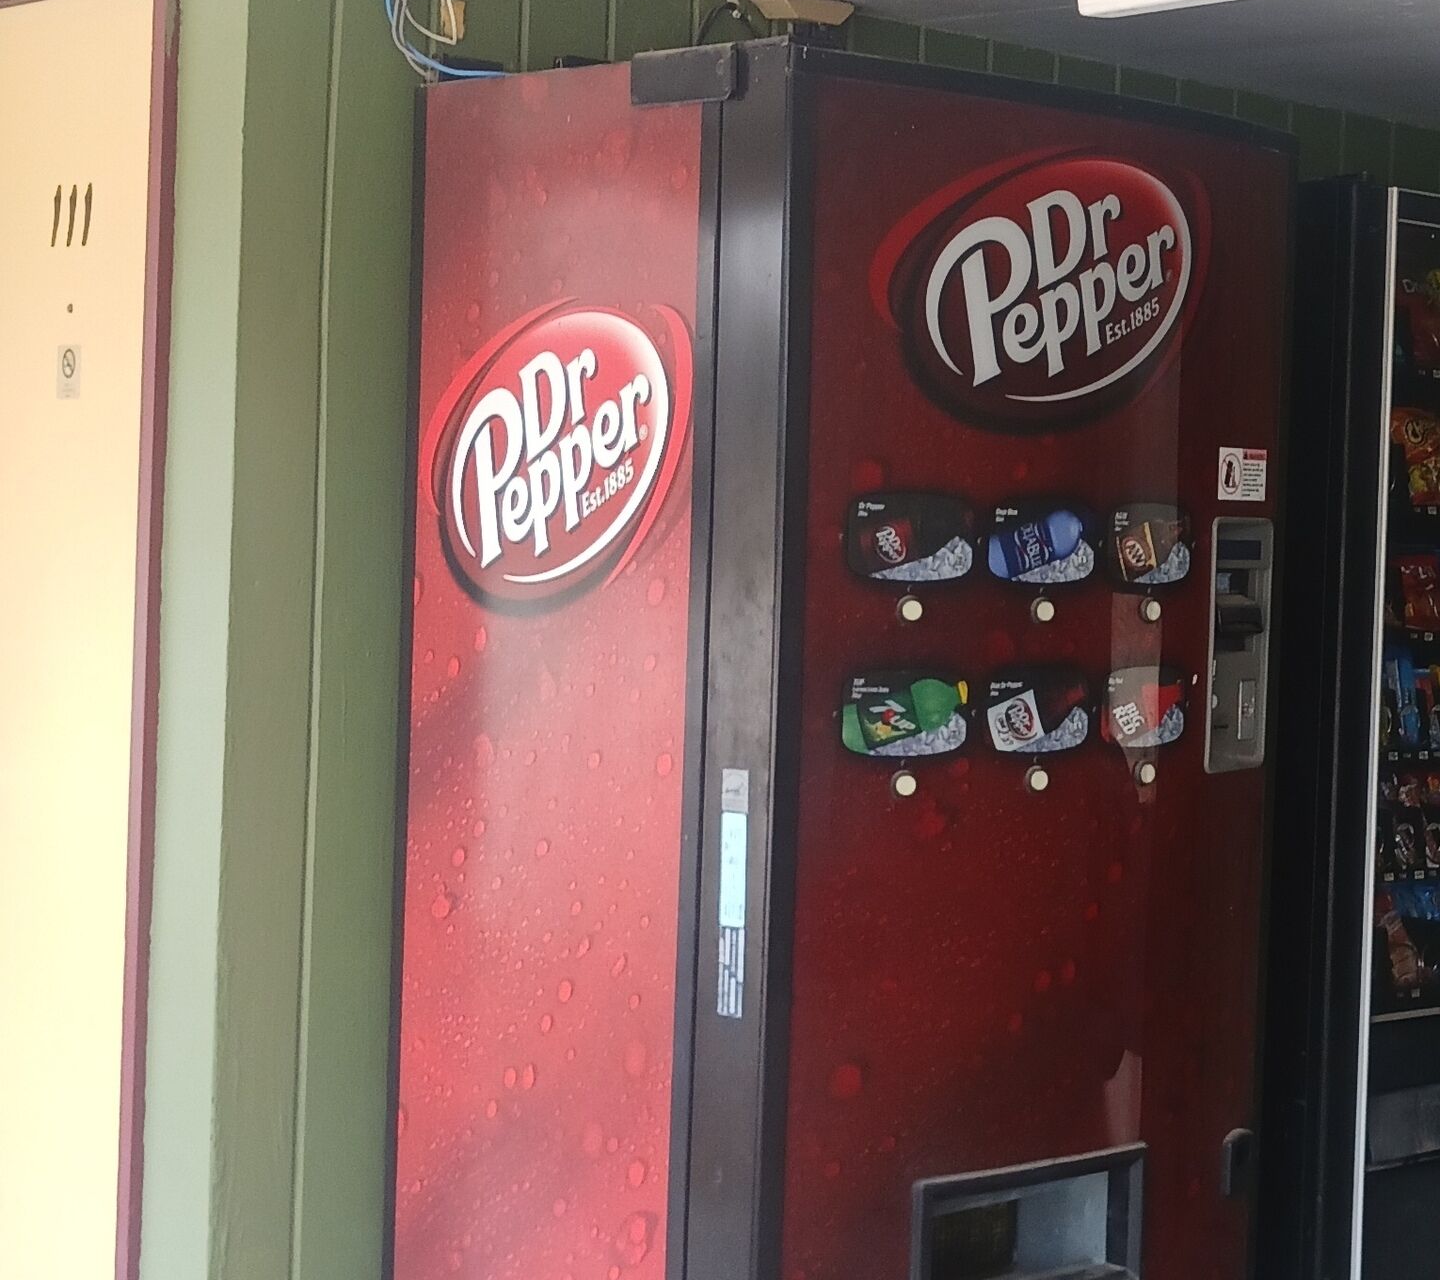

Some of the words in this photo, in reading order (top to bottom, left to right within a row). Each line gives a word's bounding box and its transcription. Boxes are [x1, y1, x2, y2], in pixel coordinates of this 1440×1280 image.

[51, 182, 92, 247] 111
[1026, 189, 1121, 290] Dr
[925, 216, 1175, 387] Pepper
[518, 348, 597, 463] Dr
[452, 373, 651, 568] Pepper
[1112, 705, 1137, 735] RED
[1124, 702, 1145, 727] BIG
